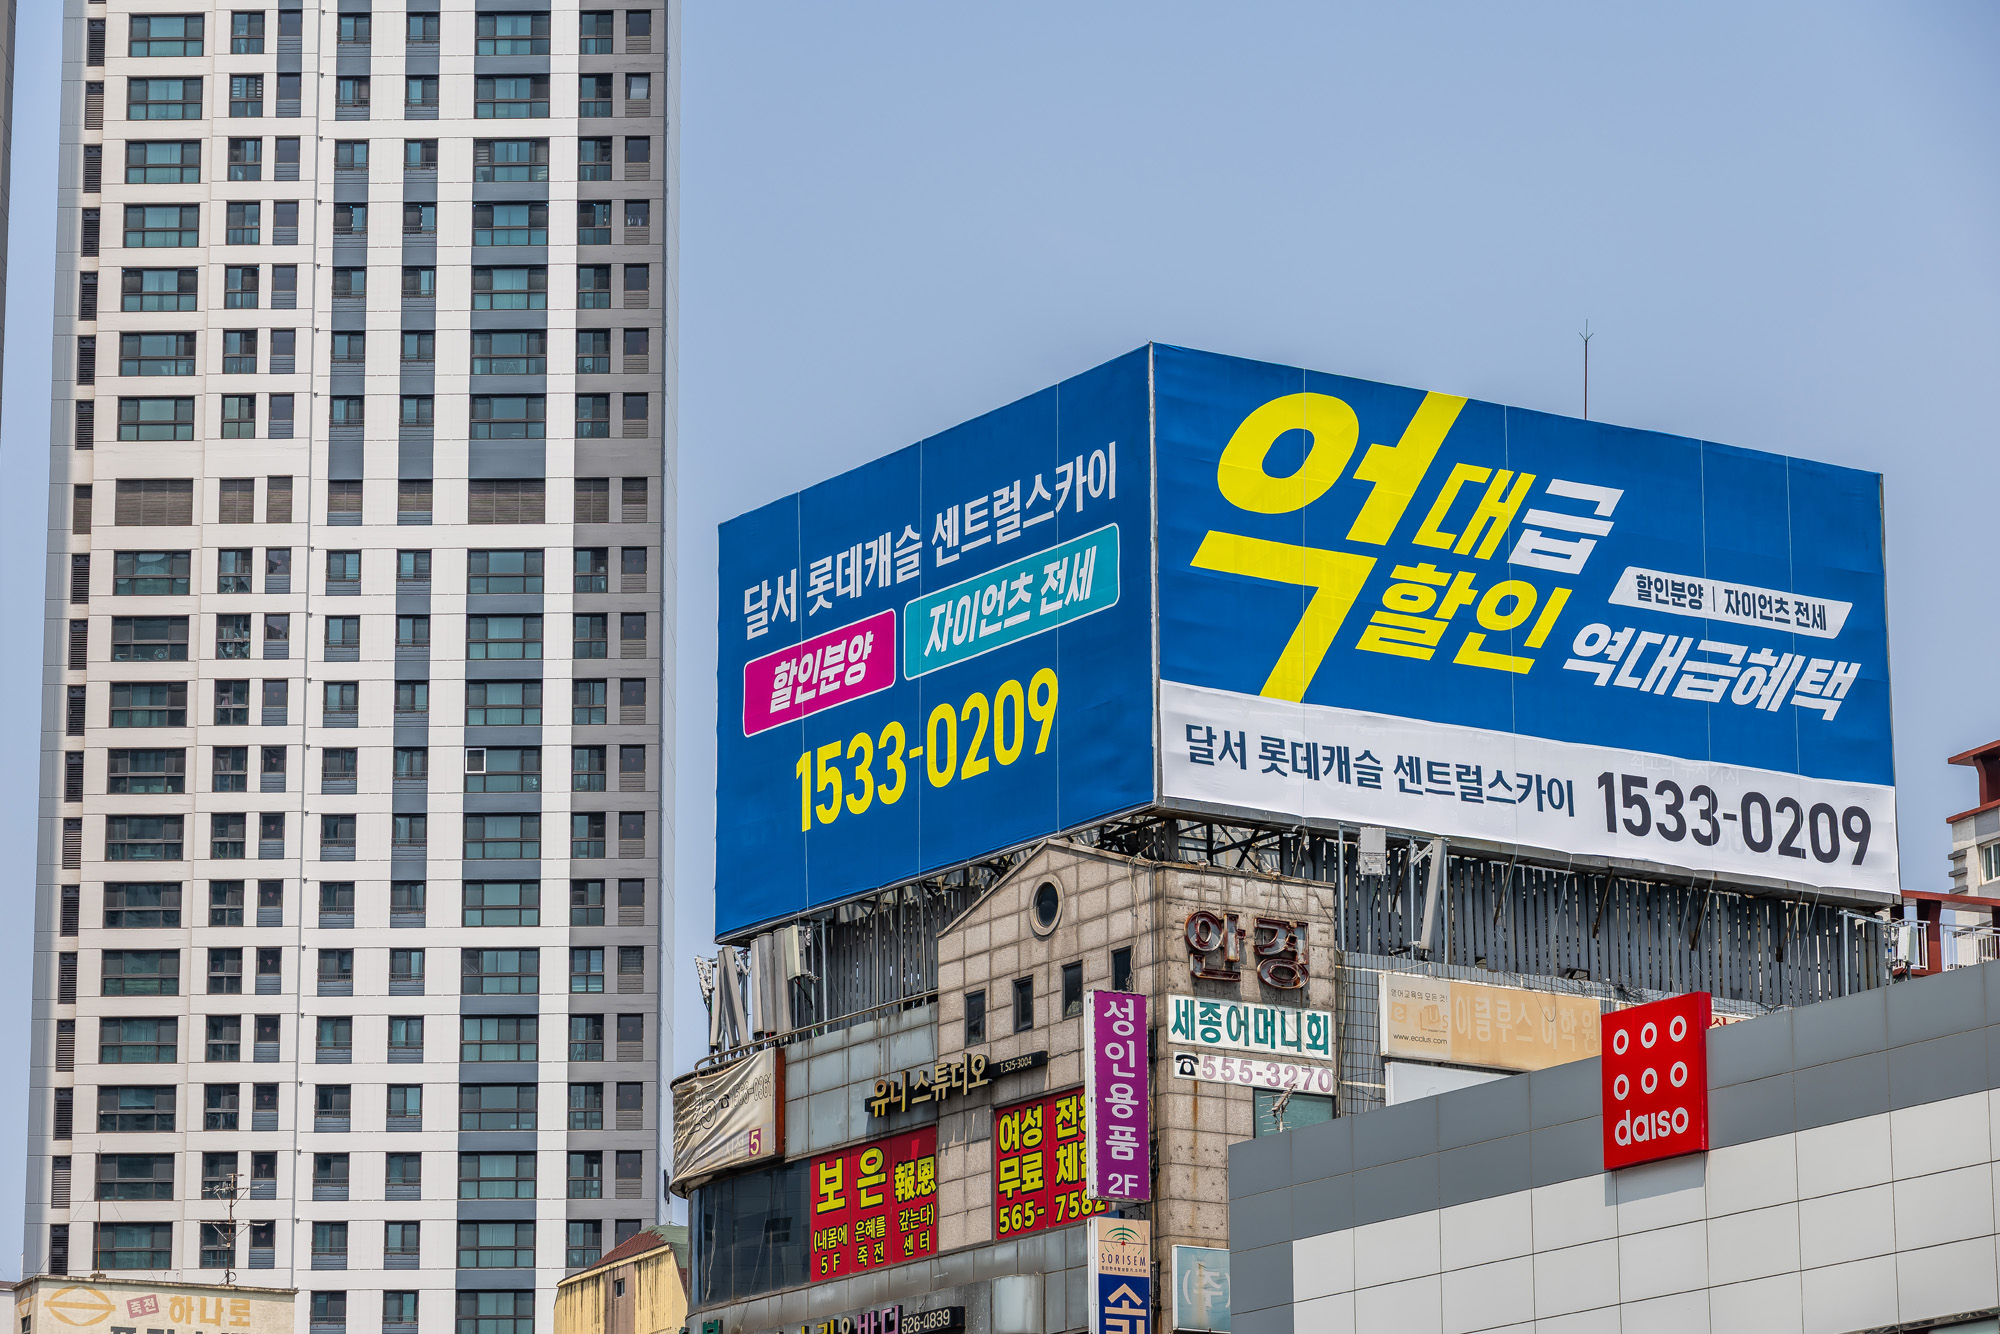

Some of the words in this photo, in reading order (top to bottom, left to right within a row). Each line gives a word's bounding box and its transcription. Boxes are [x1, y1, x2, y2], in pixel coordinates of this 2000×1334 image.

[743, 569, 798, 640] 달서
[806, 525, 923, 617] 롯데캐슬
[931, 441, 1117, 567] 센트럴스카이
[924, 571, 1033, 657] 자이언츠
[1039, 546, 1097, 616] 전세
[1355, 563, 1573, 675] 할인
[1635, 573, 1705, 611] 할인분양
[1724, 588, 1791, 624] 자이언츠
[1794, 600, 1828, 631] 전세
[769, 630, 875, 714] 할인분양
[1563, 623, 1862, 721] 역대급혜택
[795, 667, 1059, 832] 1533-0209
[1185, 723, 1247, 770] 달서
[1258, 735, 1384, 789] 롯데캐슬
[1393, 754, 1576, 817] 센트럴스카이
[1598, 771, 1872, 866] 1533-0209
[1184, 911, 1309, 989] 안경
[1171, 999, 1329, 1056] 세종어머니회
[1541, 1005, 1599, 1054] 어학원
[1104, 999, 1140, 1162] 성인용품
[1201, 1055, 1333, 1093] 555-3270
[999, 1104, 1043, 1152] 여성
[1614, 1107, 1690, 1147] daiso
[894, 1155, 937, 1203] 報恩
[998, 1151, 1044, 1199] 무료
[1108, 1172, 1139, 1196] 2F
[814, 1222, 848, 1253] (내몸에
[855, 1214, 886, 1243] 은혜를
[898, 1202, 935, 1233] 갚는다)
[1101, 1252, 1147, 1267] SORISEM
[130, 1297, 157, 1315] 죽전
[169, 1296, 251, 1326] 하나로
[901, 1309, 951, 1334] 526-4839
